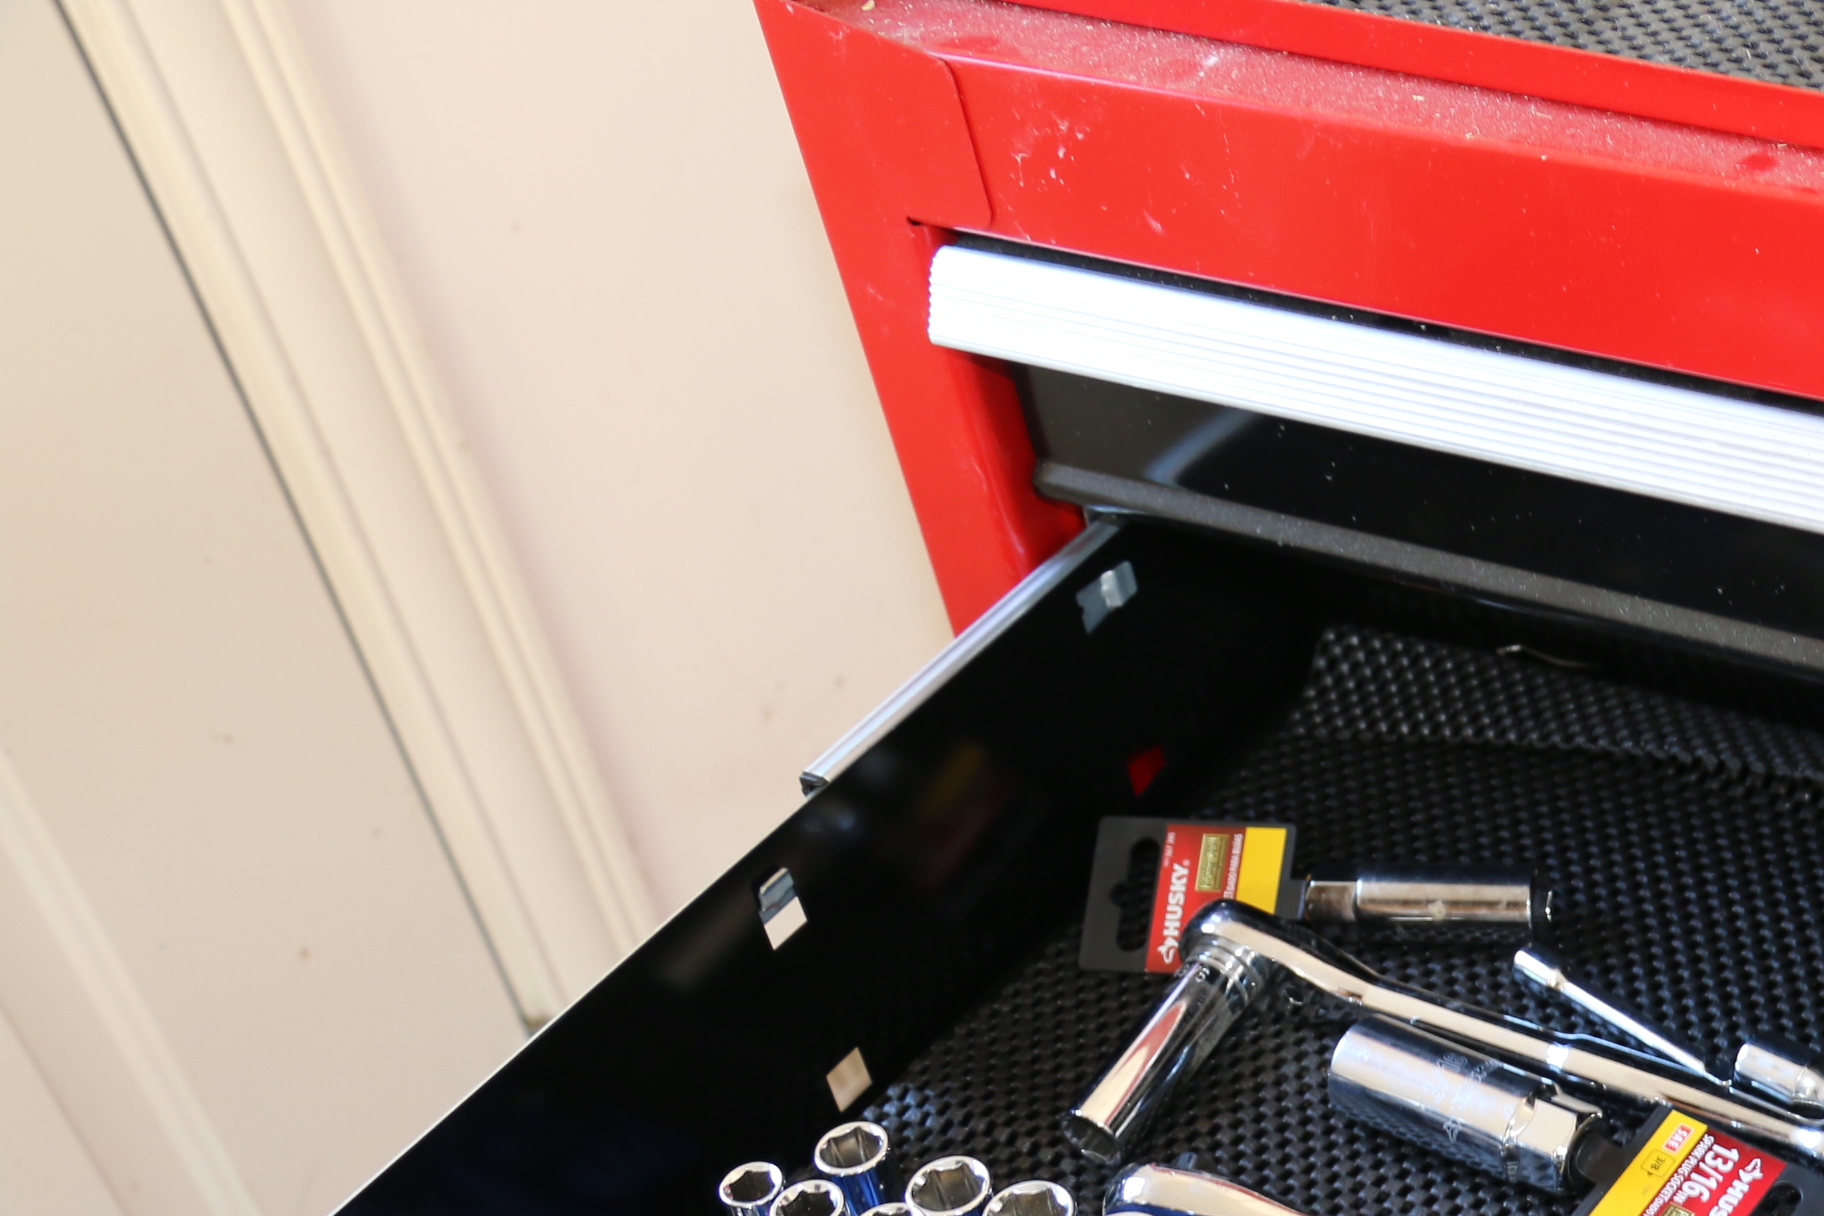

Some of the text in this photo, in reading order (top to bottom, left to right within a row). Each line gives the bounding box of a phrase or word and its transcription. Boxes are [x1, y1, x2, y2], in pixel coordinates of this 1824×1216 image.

[1163, 863, 1189, 936] HUSKY
[1670, 1128, 1688, 1149] SAE
[1691, 1134, 1714, 1157] SPARK
[1651, 1156, 1665, 1170] 3/8
[1672, 1143, 1740, 1205] 13/16 IN
[1678, 1155, 1696, 1175] PLUG
[1660, 1169, 1684, 1201] SOCKET
[1646, 1195, 1663, 1214] DADO
